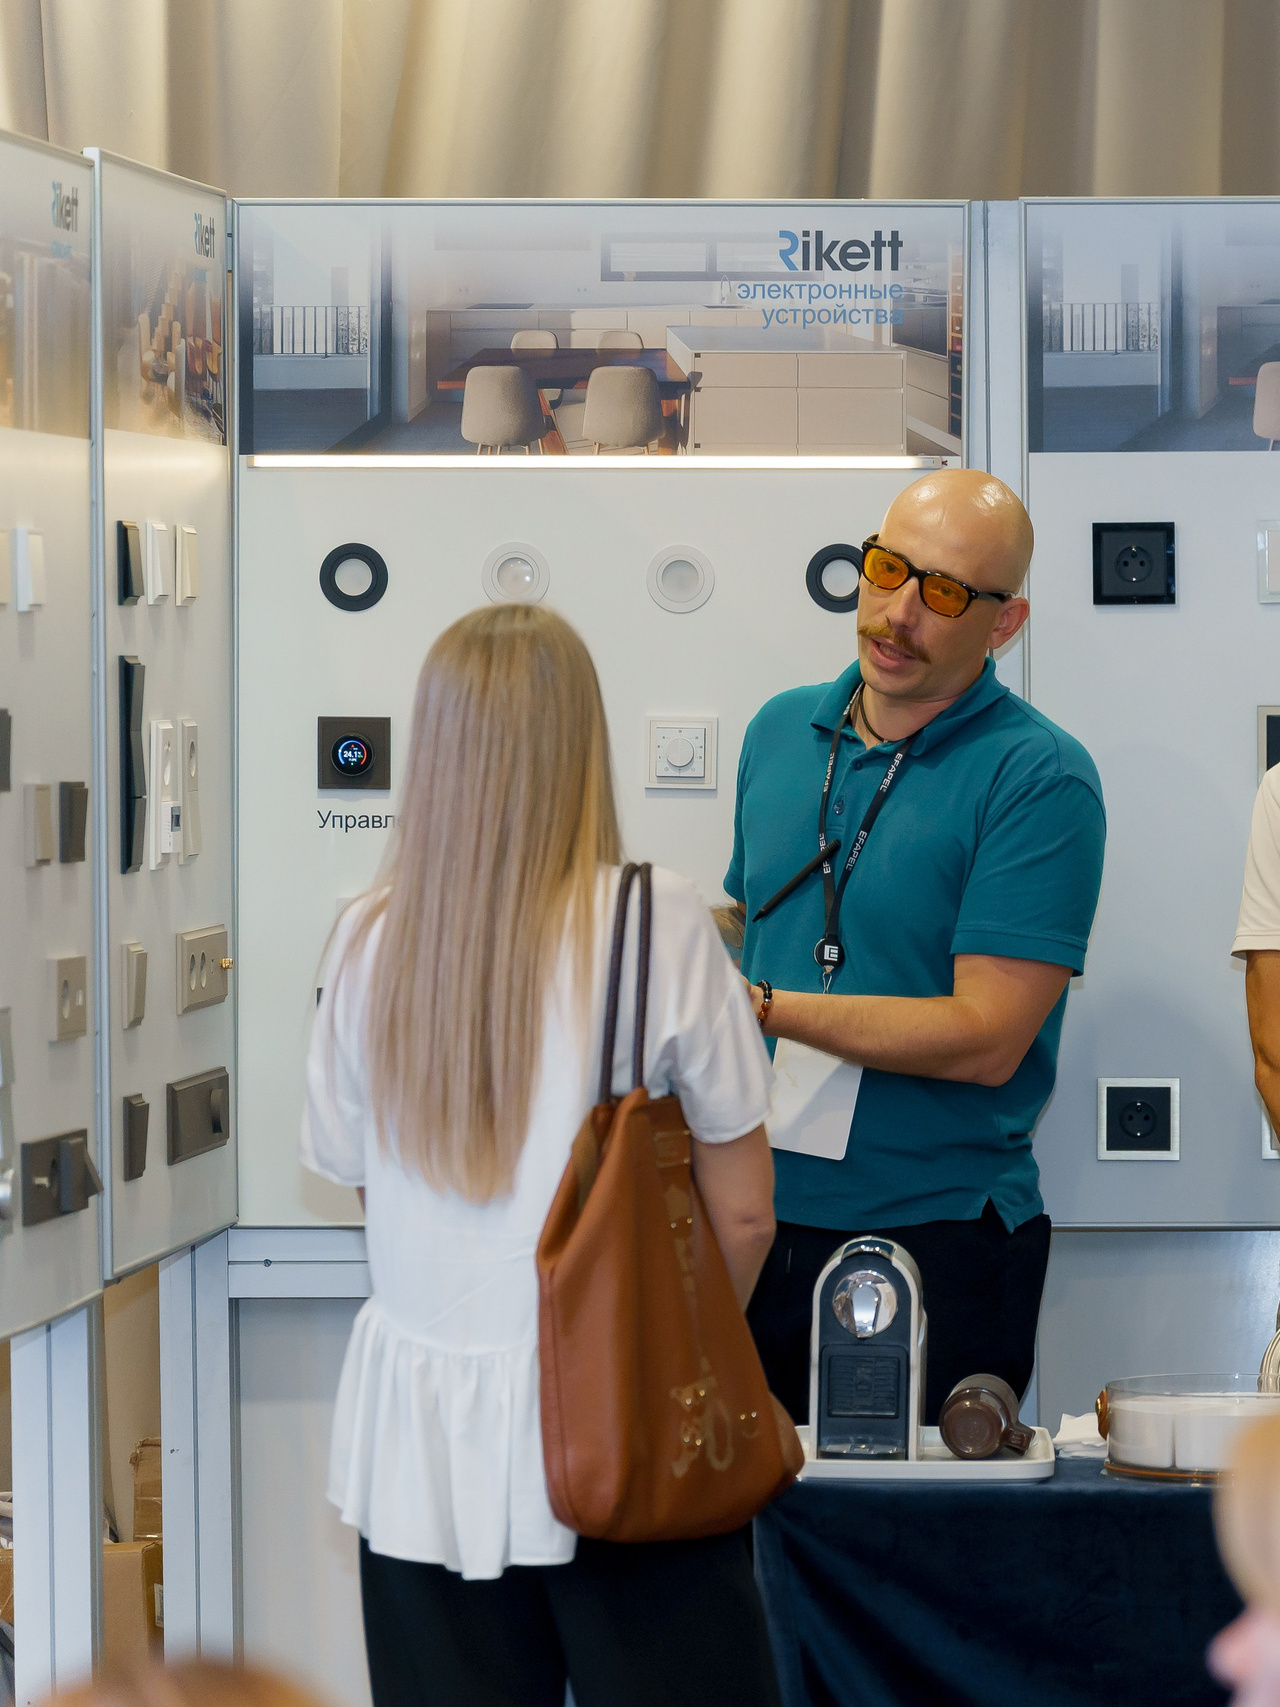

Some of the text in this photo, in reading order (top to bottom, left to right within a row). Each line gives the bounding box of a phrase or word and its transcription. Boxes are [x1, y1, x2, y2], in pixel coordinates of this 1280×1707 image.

[778, 229, 904, 272] Rikett
[736, 282, 904, 305] электронные
[761, 303, 904, 330] устройства
